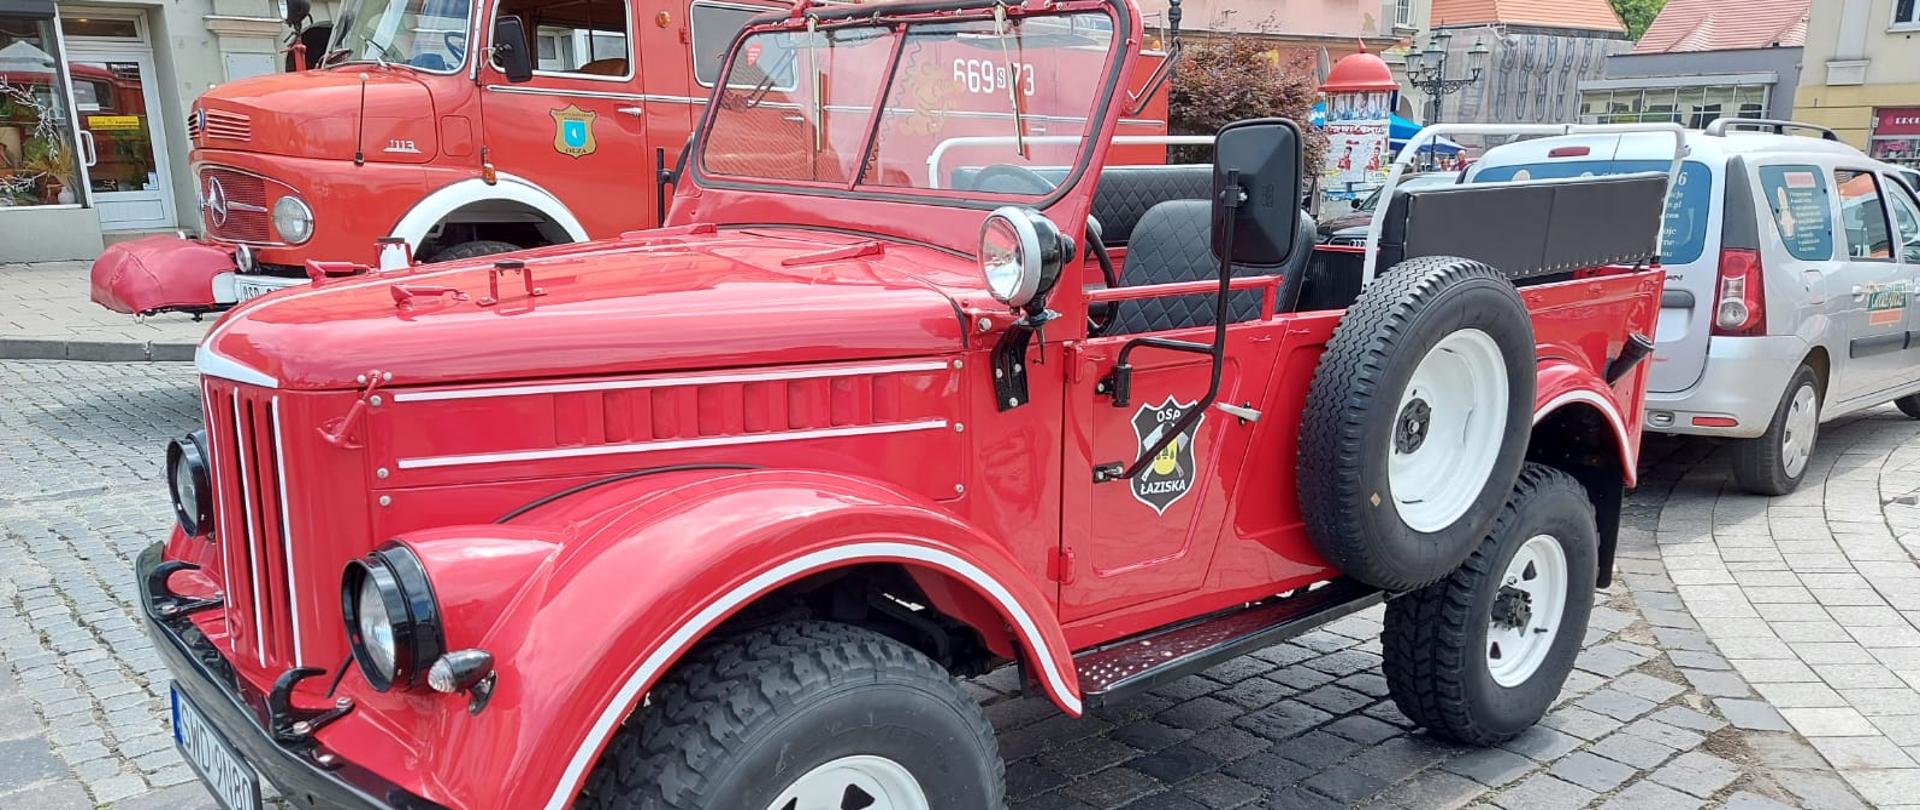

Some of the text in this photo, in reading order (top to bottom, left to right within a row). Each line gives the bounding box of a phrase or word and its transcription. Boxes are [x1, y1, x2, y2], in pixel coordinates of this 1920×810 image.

[954, 58, 995, 94] 669
[1156, 408, 1181, 423] OSP
[1140, 479, 1186, 495] ŁAZISKA
[181, 703, 210, 773] SWD
